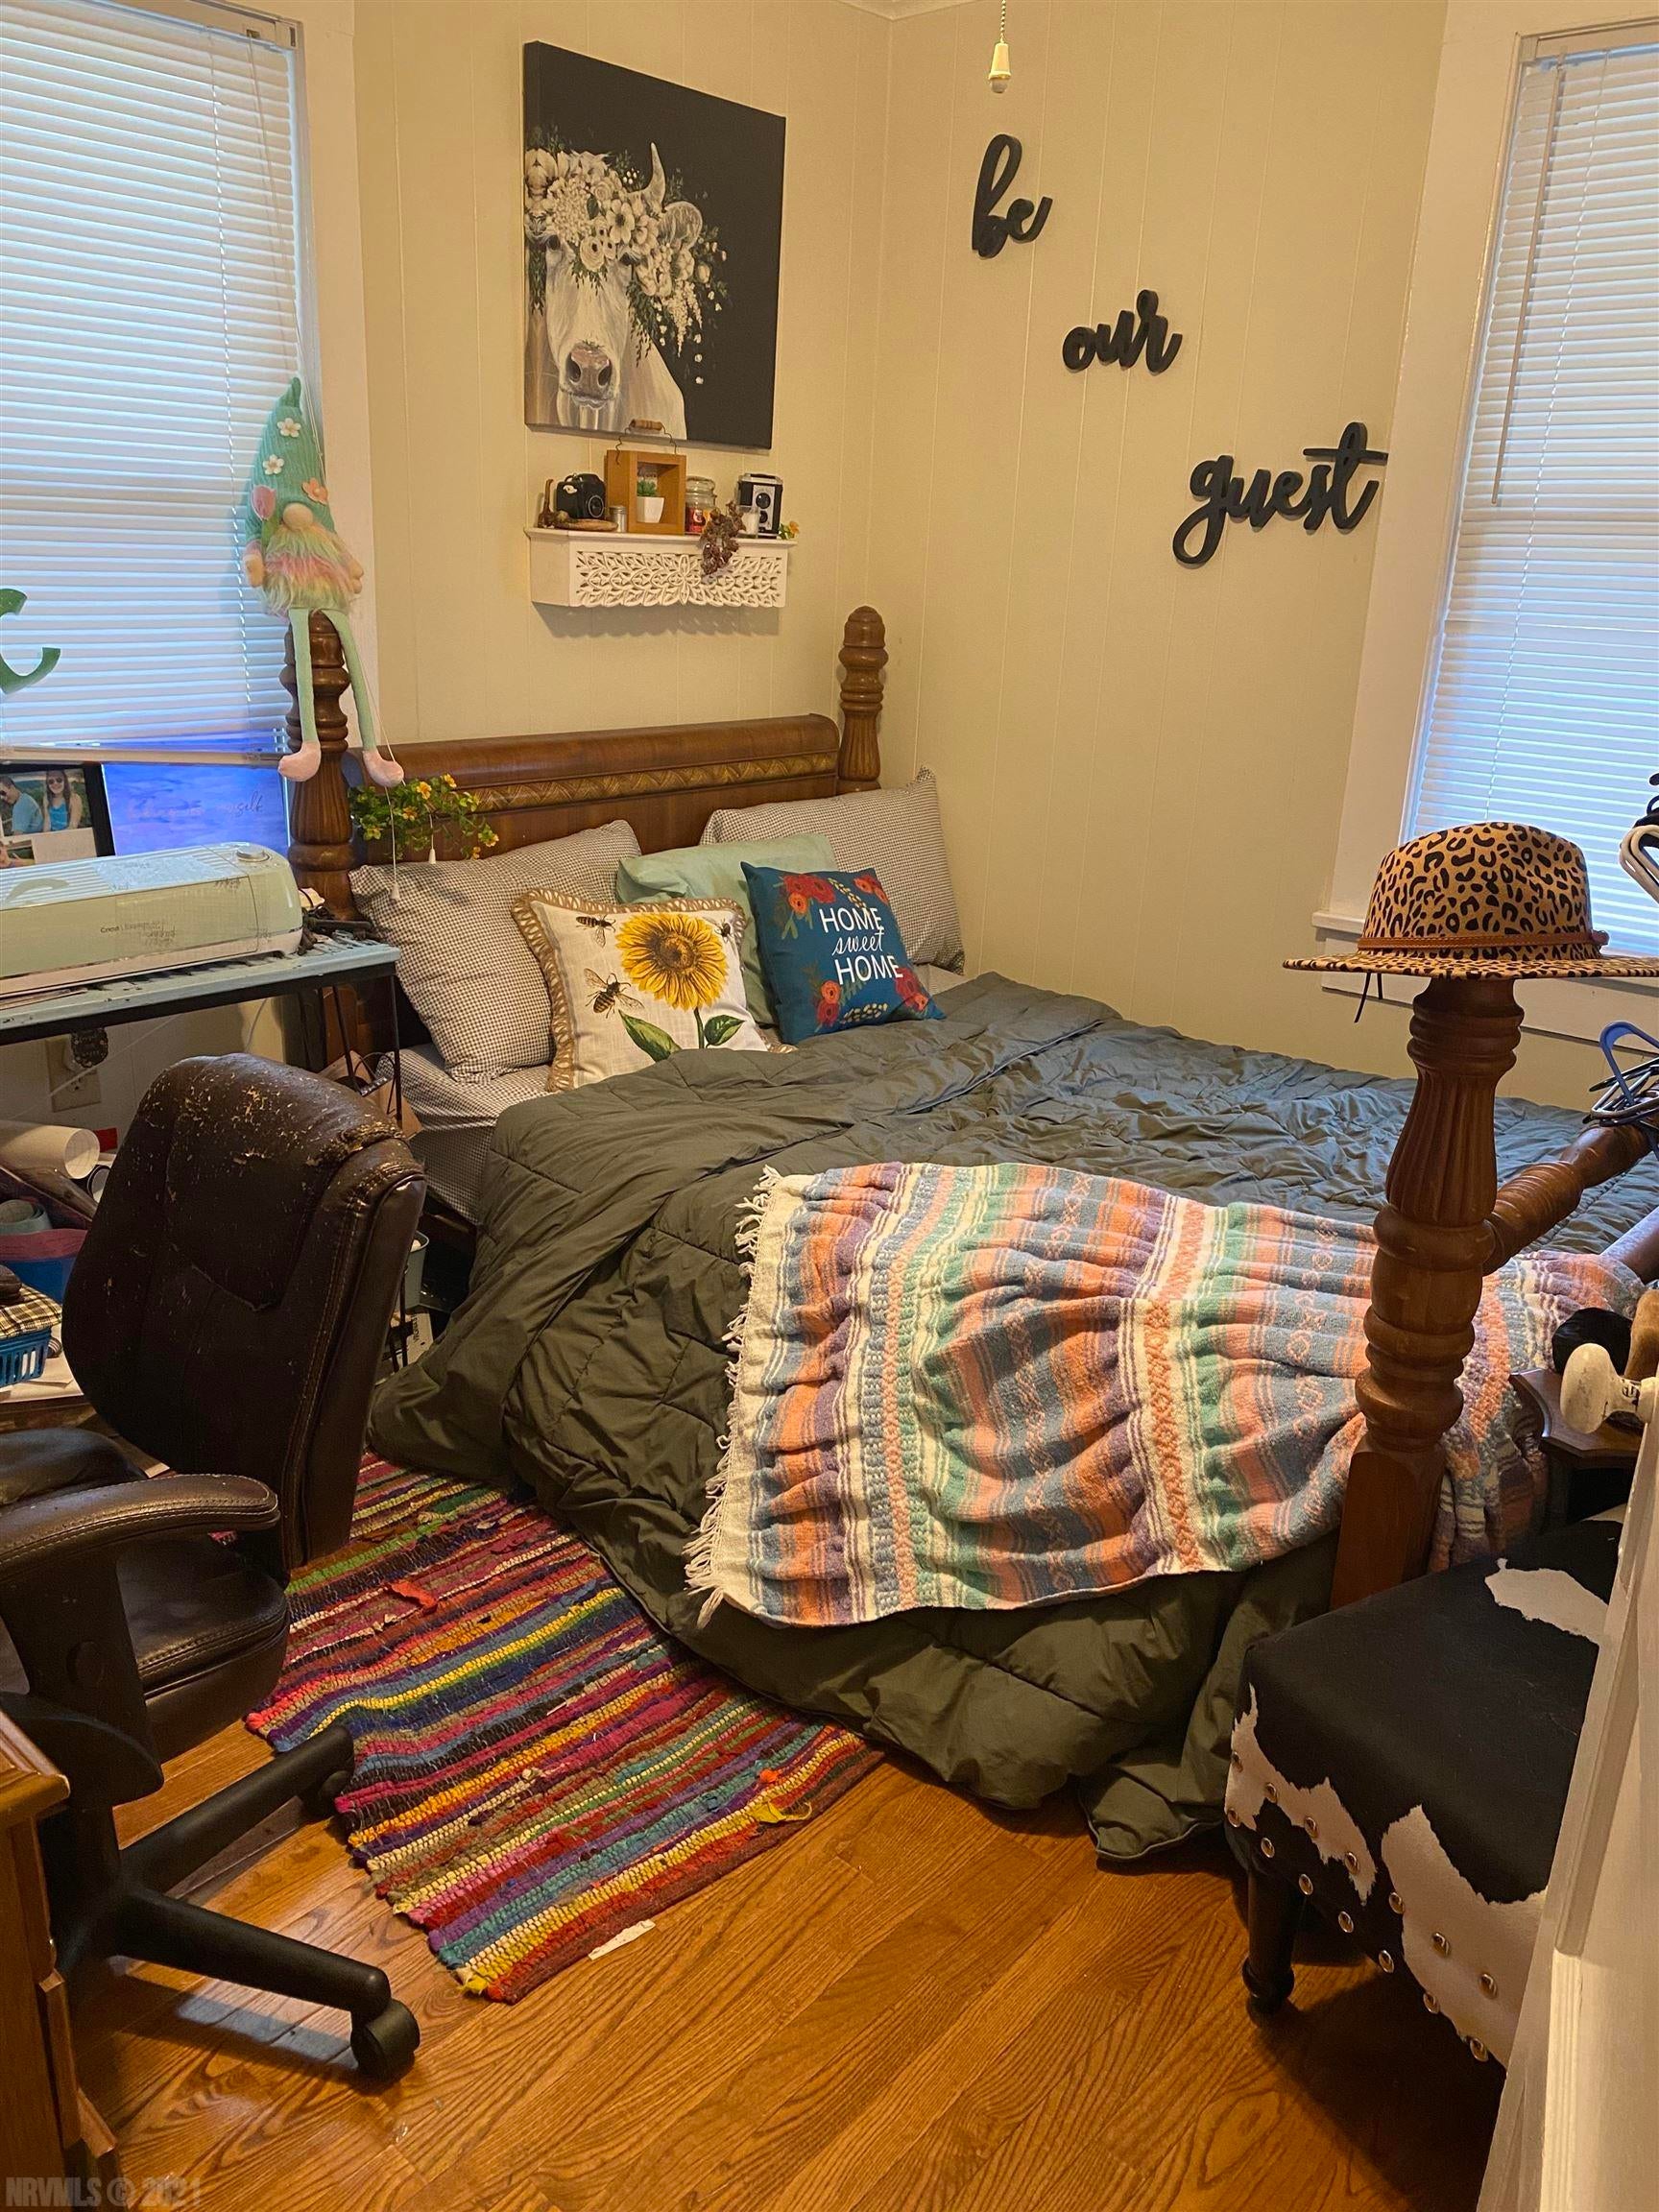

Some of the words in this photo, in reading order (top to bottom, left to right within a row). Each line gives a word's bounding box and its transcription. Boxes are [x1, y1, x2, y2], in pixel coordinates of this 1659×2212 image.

[972, 133, 1053, 258] be
[1063, 289, 1183, 373] our
[1172, 421, 1388, 565] guest
[820, 907, 884, 932] HOME
[831, 929, 884, 956] sweet
[834, 955, 903, 985] HOME
